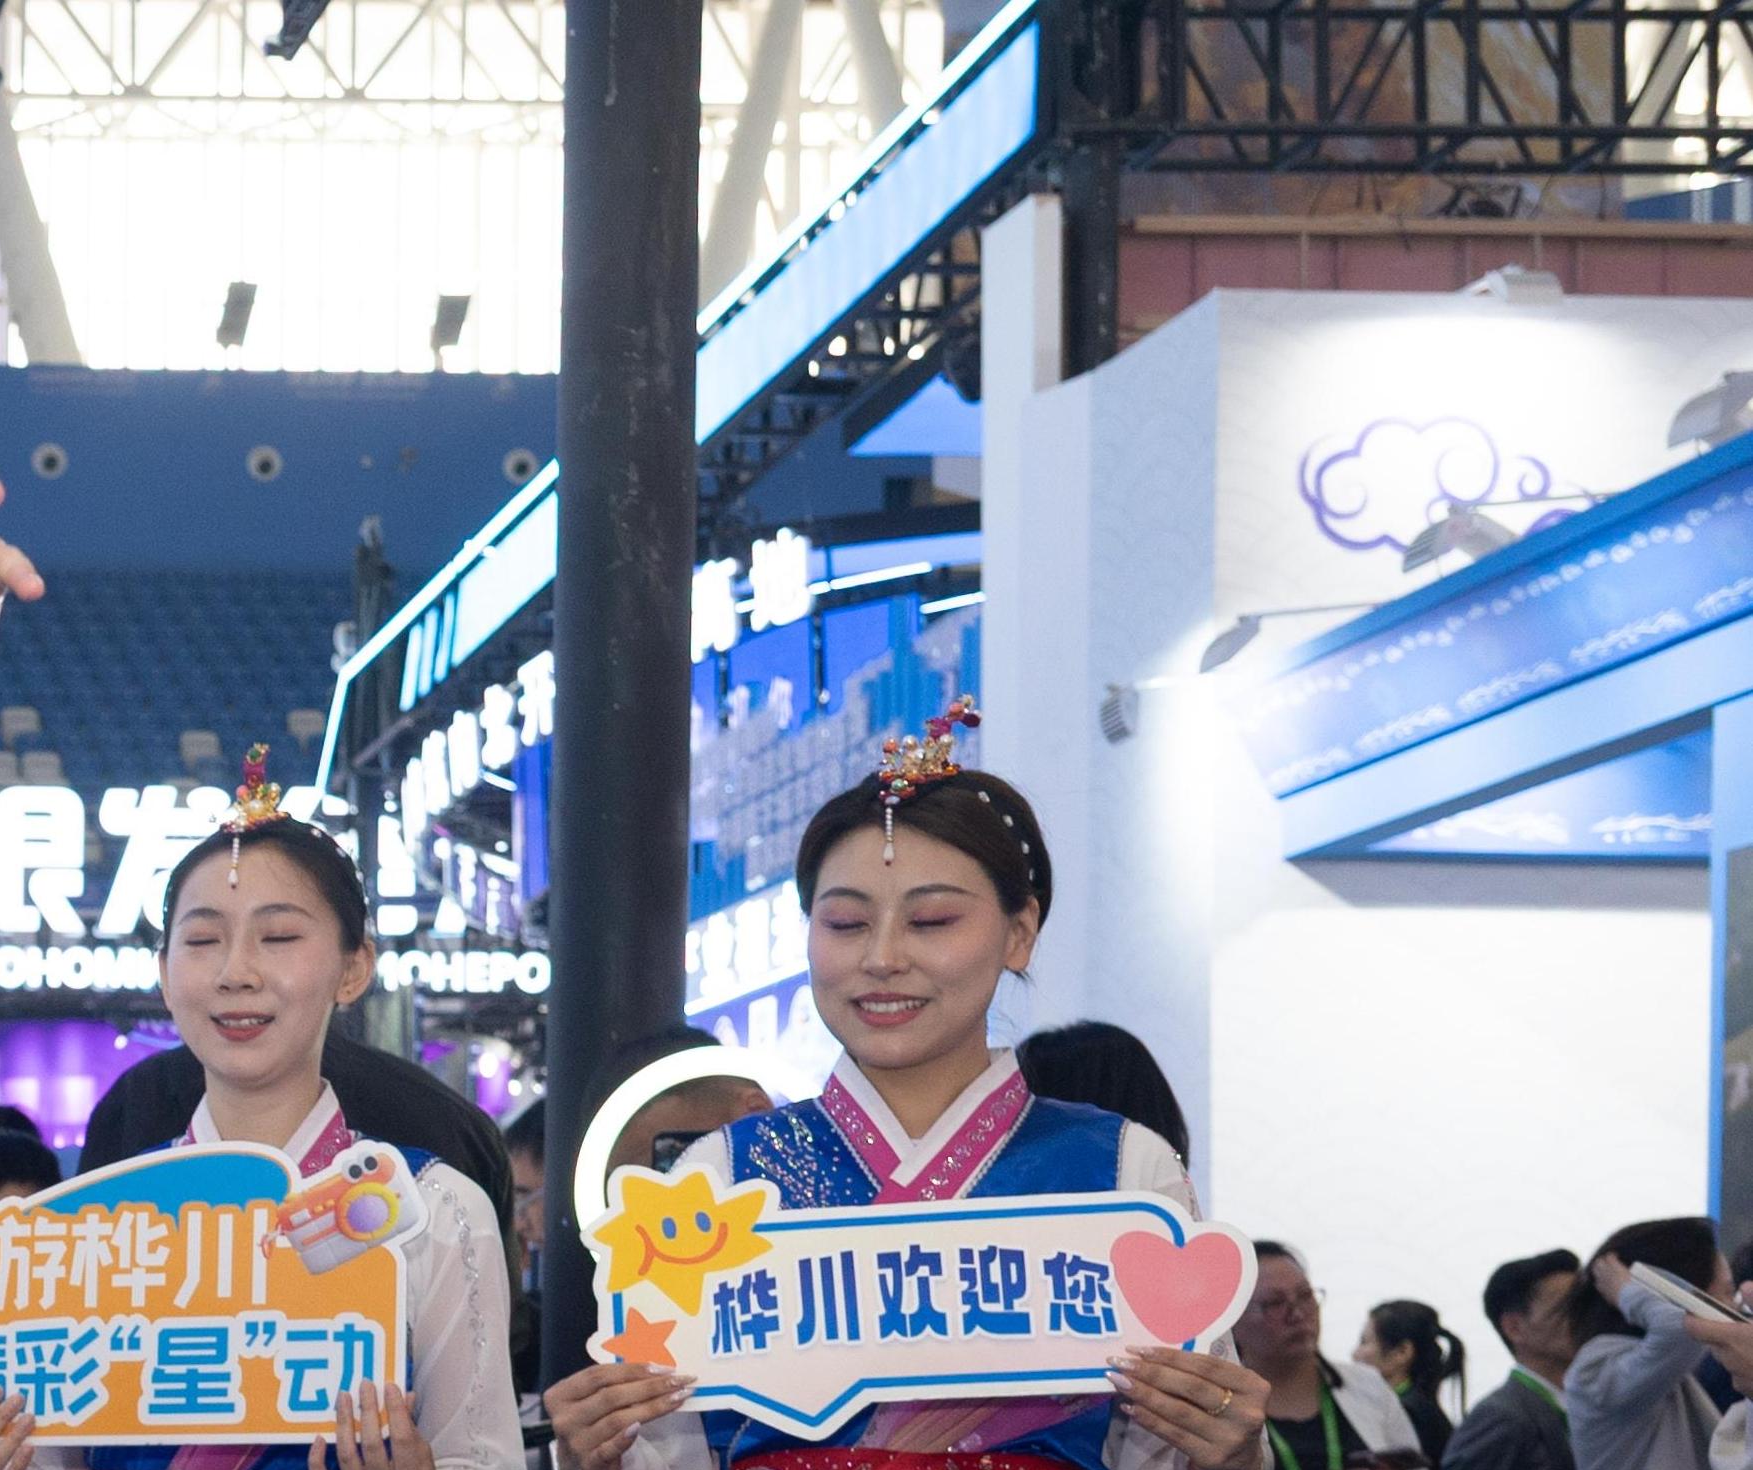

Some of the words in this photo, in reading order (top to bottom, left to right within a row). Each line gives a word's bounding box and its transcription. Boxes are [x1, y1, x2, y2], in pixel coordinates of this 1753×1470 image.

[711, 1244, 1119, 1355] 桦川欢迎您
